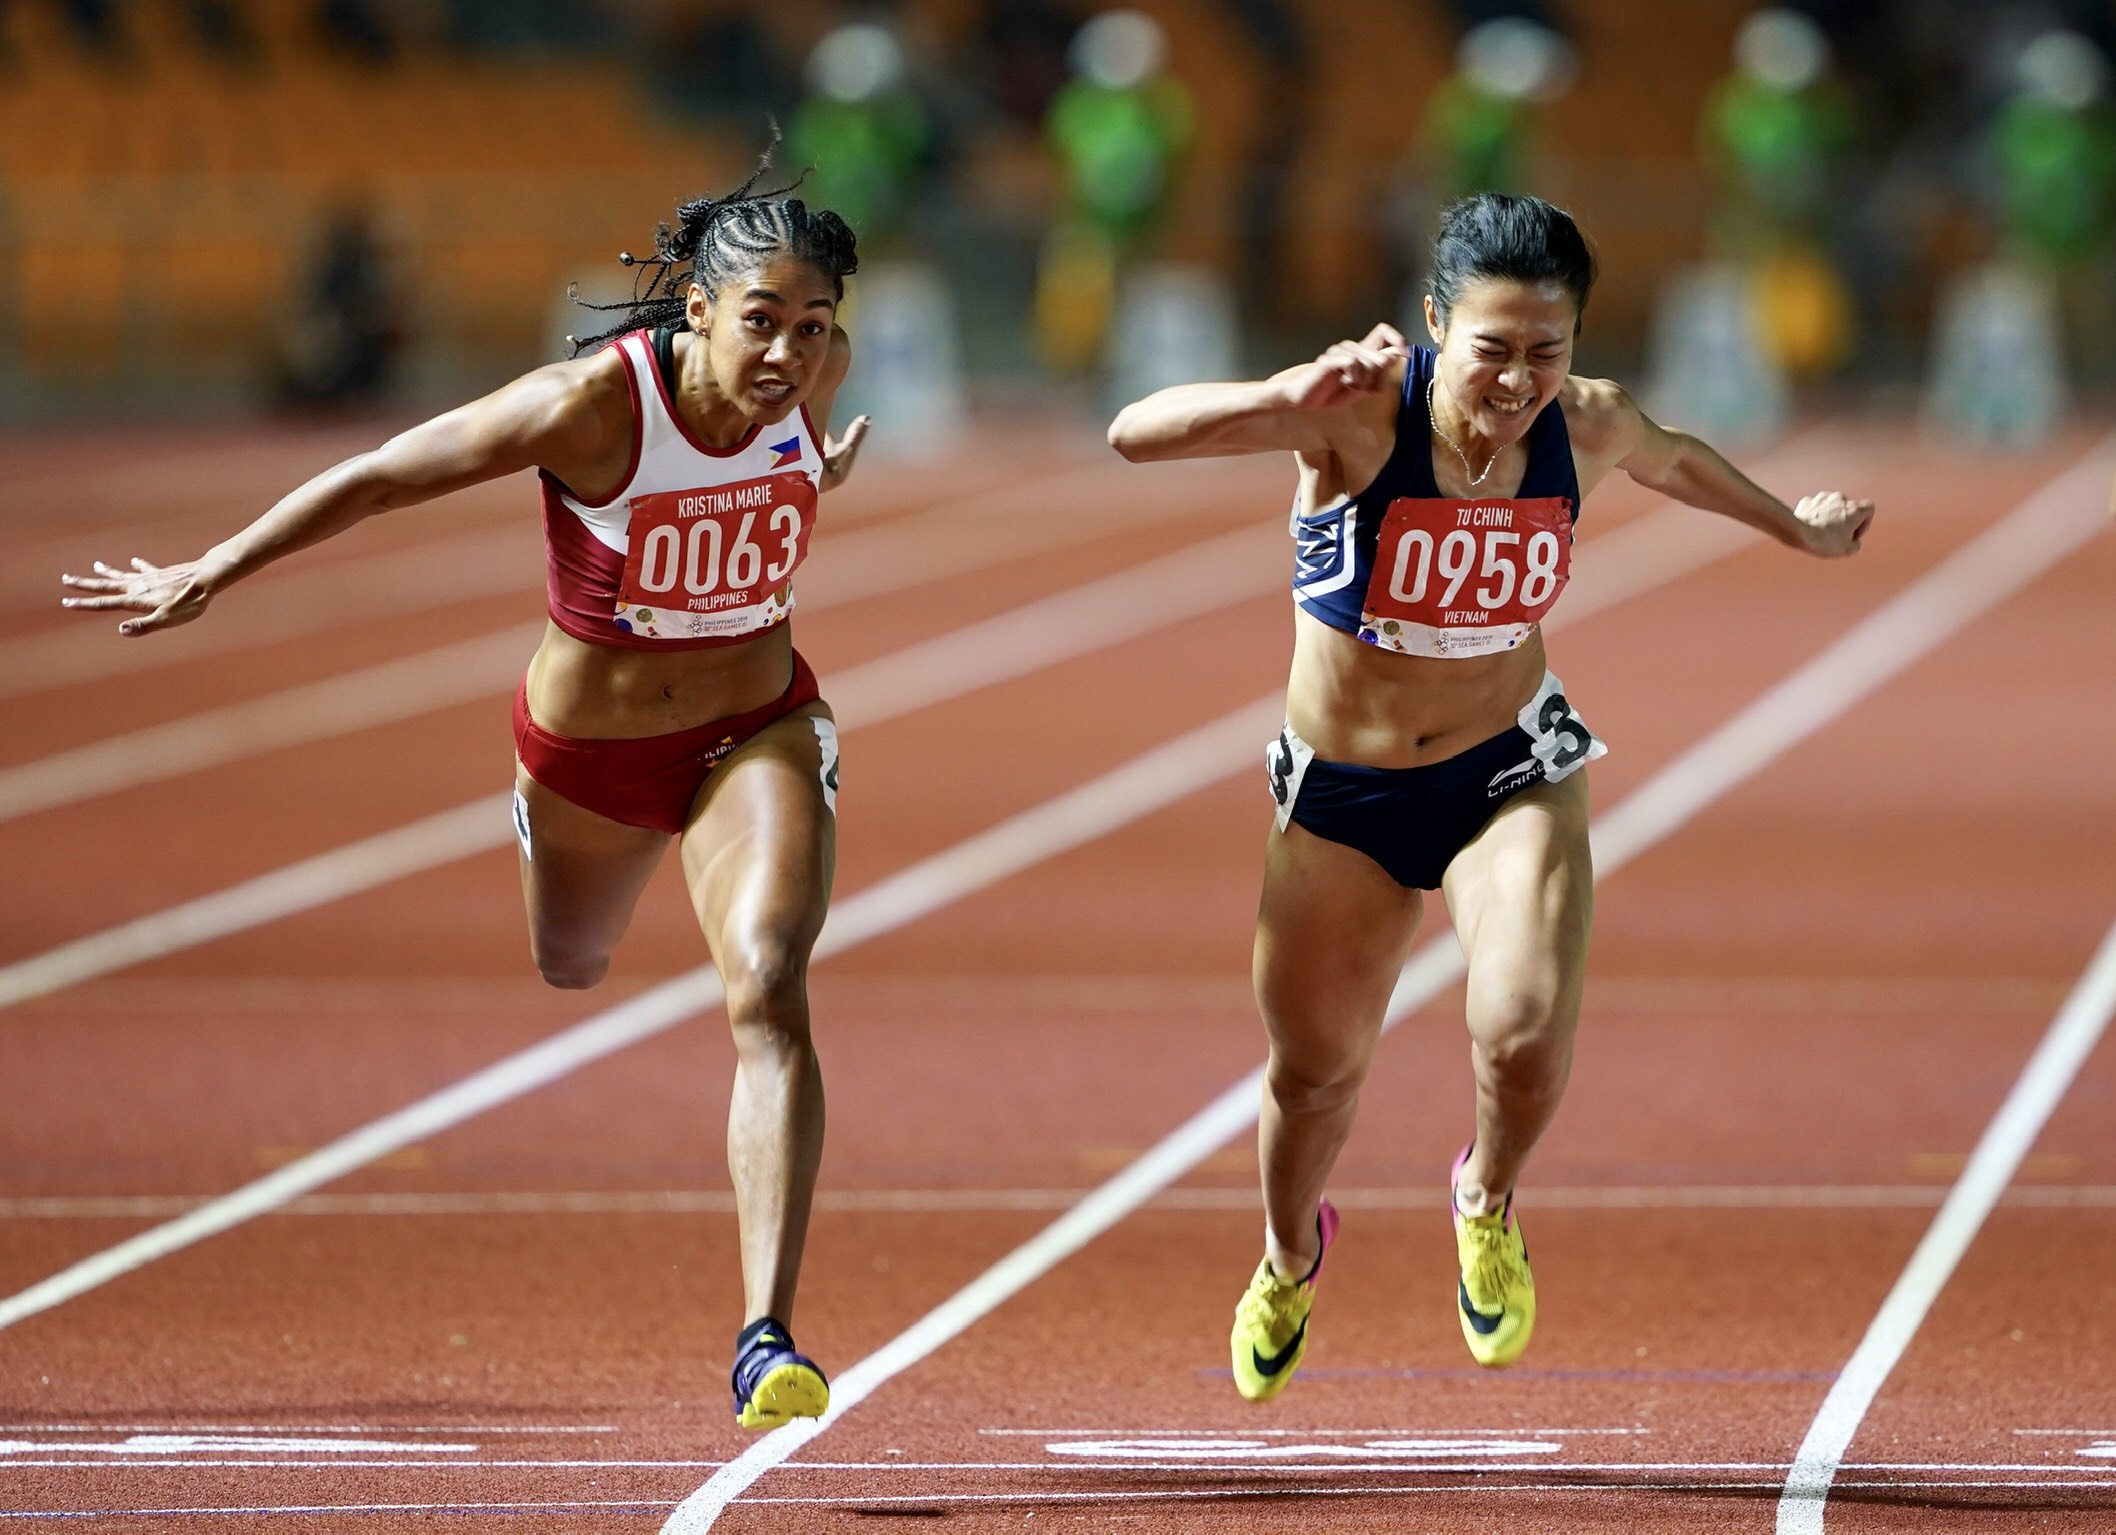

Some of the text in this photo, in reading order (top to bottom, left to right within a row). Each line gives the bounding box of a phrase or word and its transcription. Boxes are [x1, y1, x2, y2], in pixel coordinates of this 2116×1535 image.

[678, 484, 772, 518] KRISTINA MARIE
[1456, 507, 1514, 527] TU CHINH
[639, 504, 802, 596] 0063
[1389, 529, 1560, 609] 0958
[687, 591, 749, 611] PHILIPPINES
[704, 617, 737, 626] PHILIPPINES
[1443, 610, 1489, 625] VIETNAM
